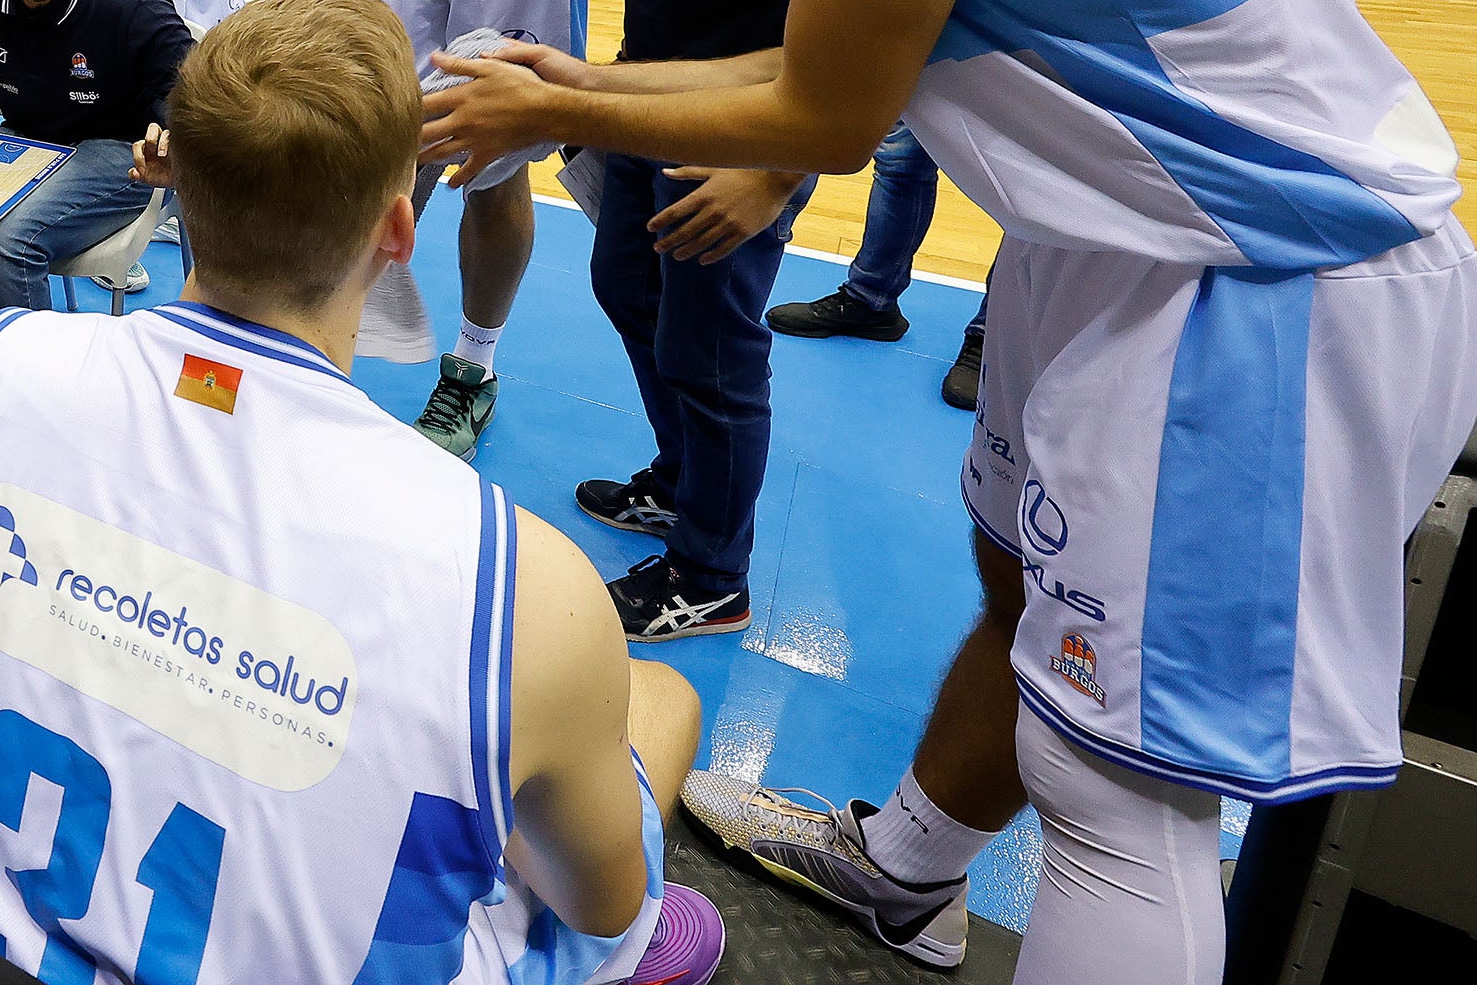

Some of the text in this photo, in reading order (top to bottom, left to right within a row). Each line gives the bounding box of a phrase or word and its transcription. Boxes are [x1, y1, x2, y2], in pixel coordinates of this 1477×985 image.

[55, 568, 349, 716] recoletas salud
[1052, 655, 1104, 701] BURGOS
